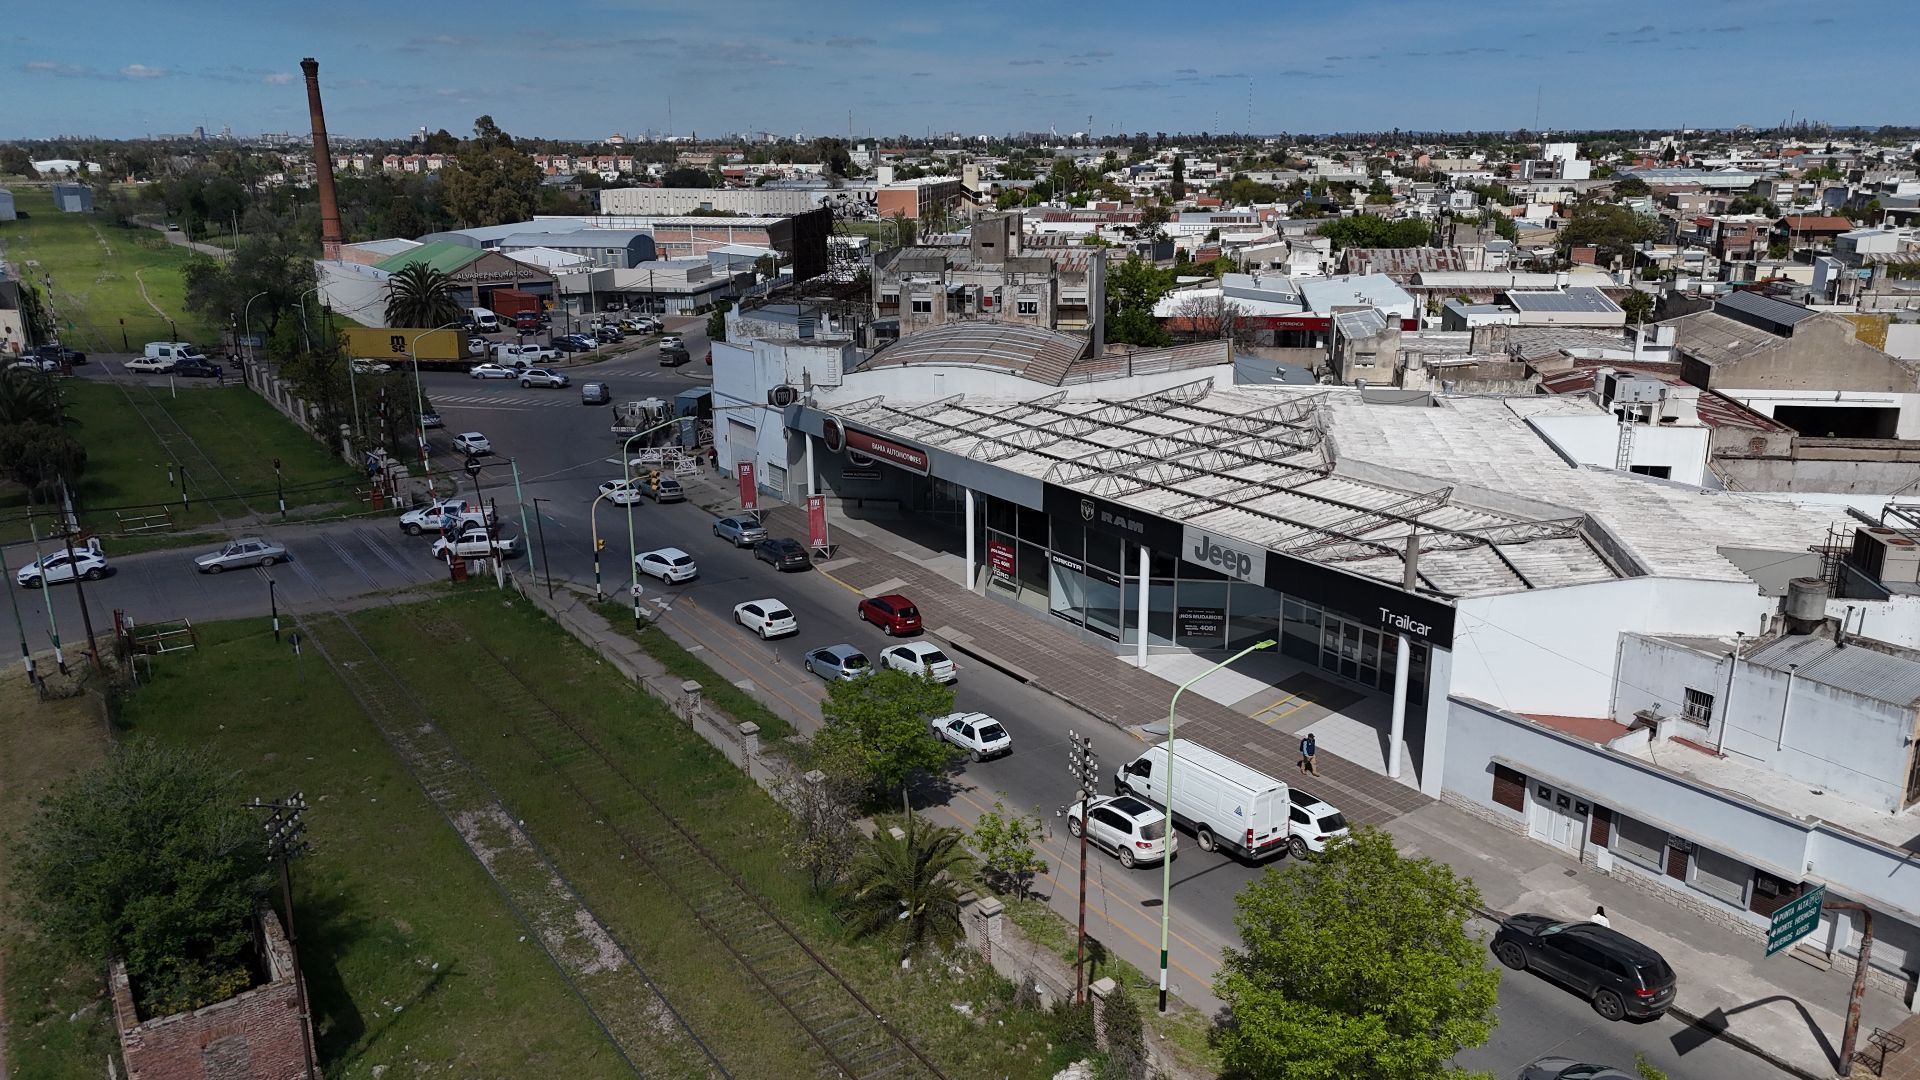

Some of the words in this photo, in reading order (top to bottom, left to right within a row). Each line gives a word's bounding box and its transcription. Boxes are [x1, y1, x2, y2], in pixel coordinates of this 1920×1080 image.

[1101, 511, 1144, 534] RAM
[1052, 555, 1083, 571] DAKOTA
[1194, 535, 1252, 579] Jeep
[1379, 607, 1433, 637] Trailcar
[1777, 920, 1793, 935] MONTE
[1794, 906, 1817, 926] HERMOSO
[1778, 907, 1795, 922] PUNTA
[1773, 932, 1793, 949] BUENOS
